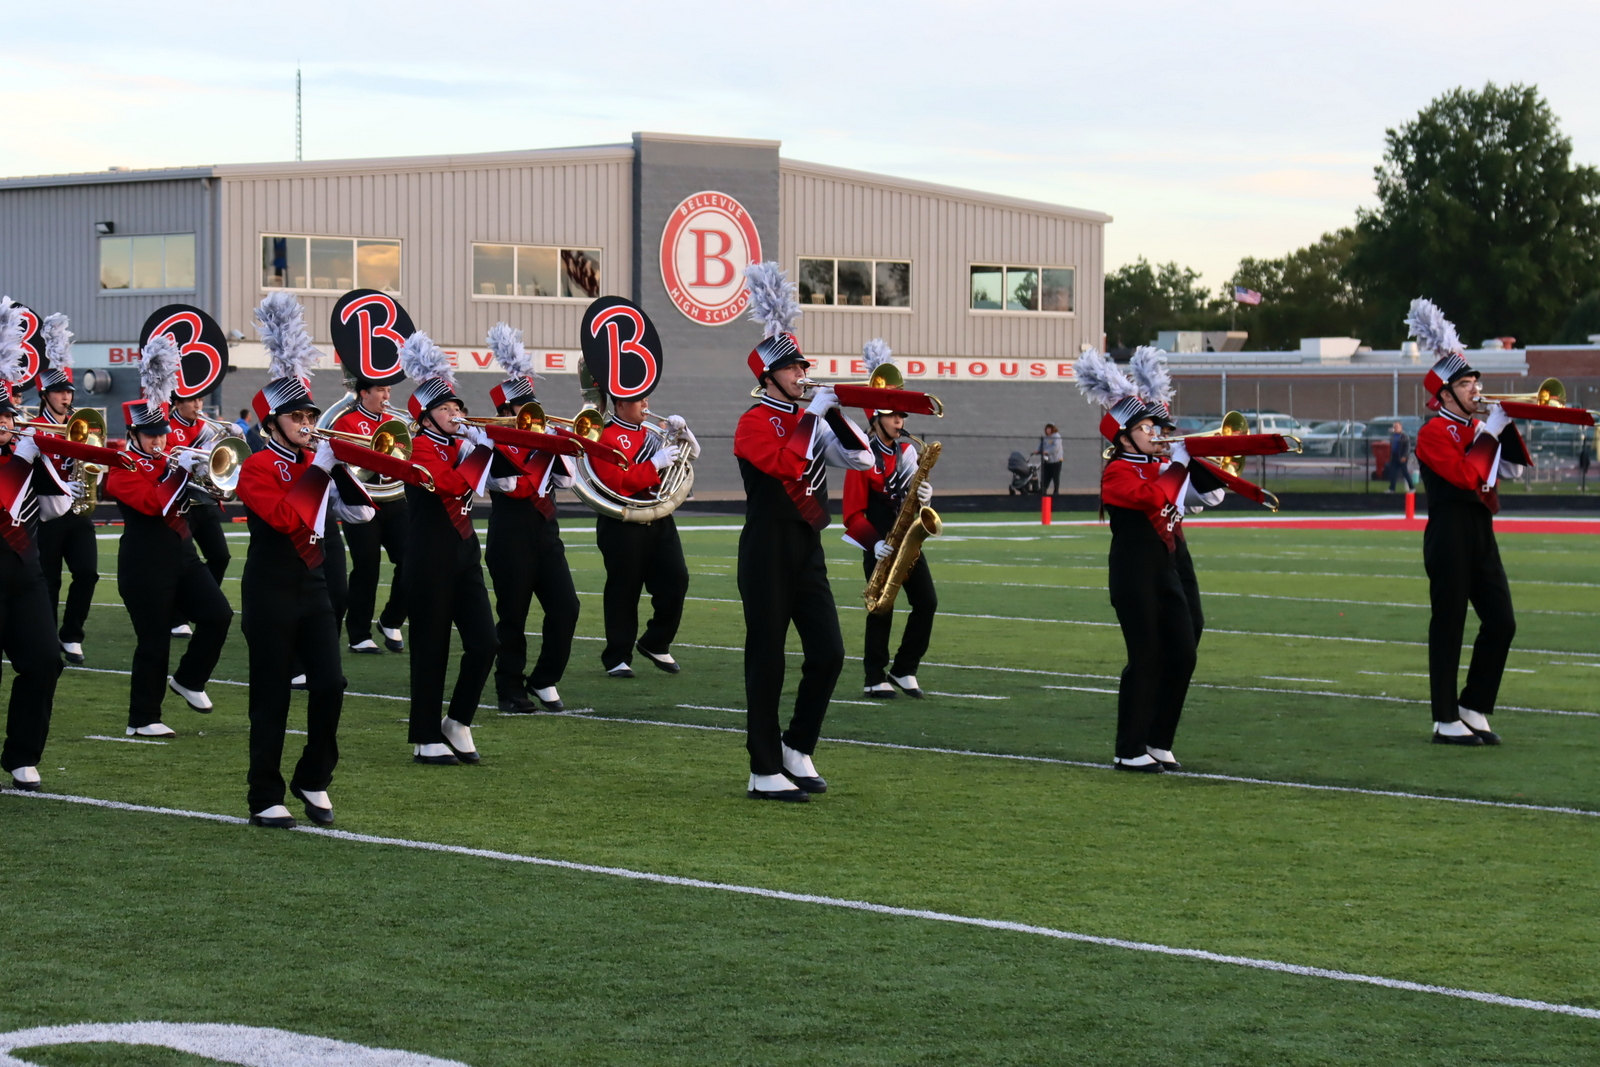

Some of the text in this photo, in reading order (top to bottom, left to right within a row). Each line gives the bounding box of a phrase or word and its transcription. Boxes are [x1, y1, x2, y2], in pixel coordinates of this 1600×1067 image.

[680, 195, 744, 219] BELLEVUE
[688, 229, 735, 287] B
[670, 287, 700, 317] HIGH
[341, 293, 405, 379] B
[146, 311, 222, 398] B
[590, 305, 657, 398] B
[805, 358, 1074, 378] FIEDHOUSE
[173, 428, 186, 442] B
[358, 421, 371, 436] B
[769, 416, 786, 437] B
[617, 434, 632, 449] B
[274, 460, 292, 482] B
